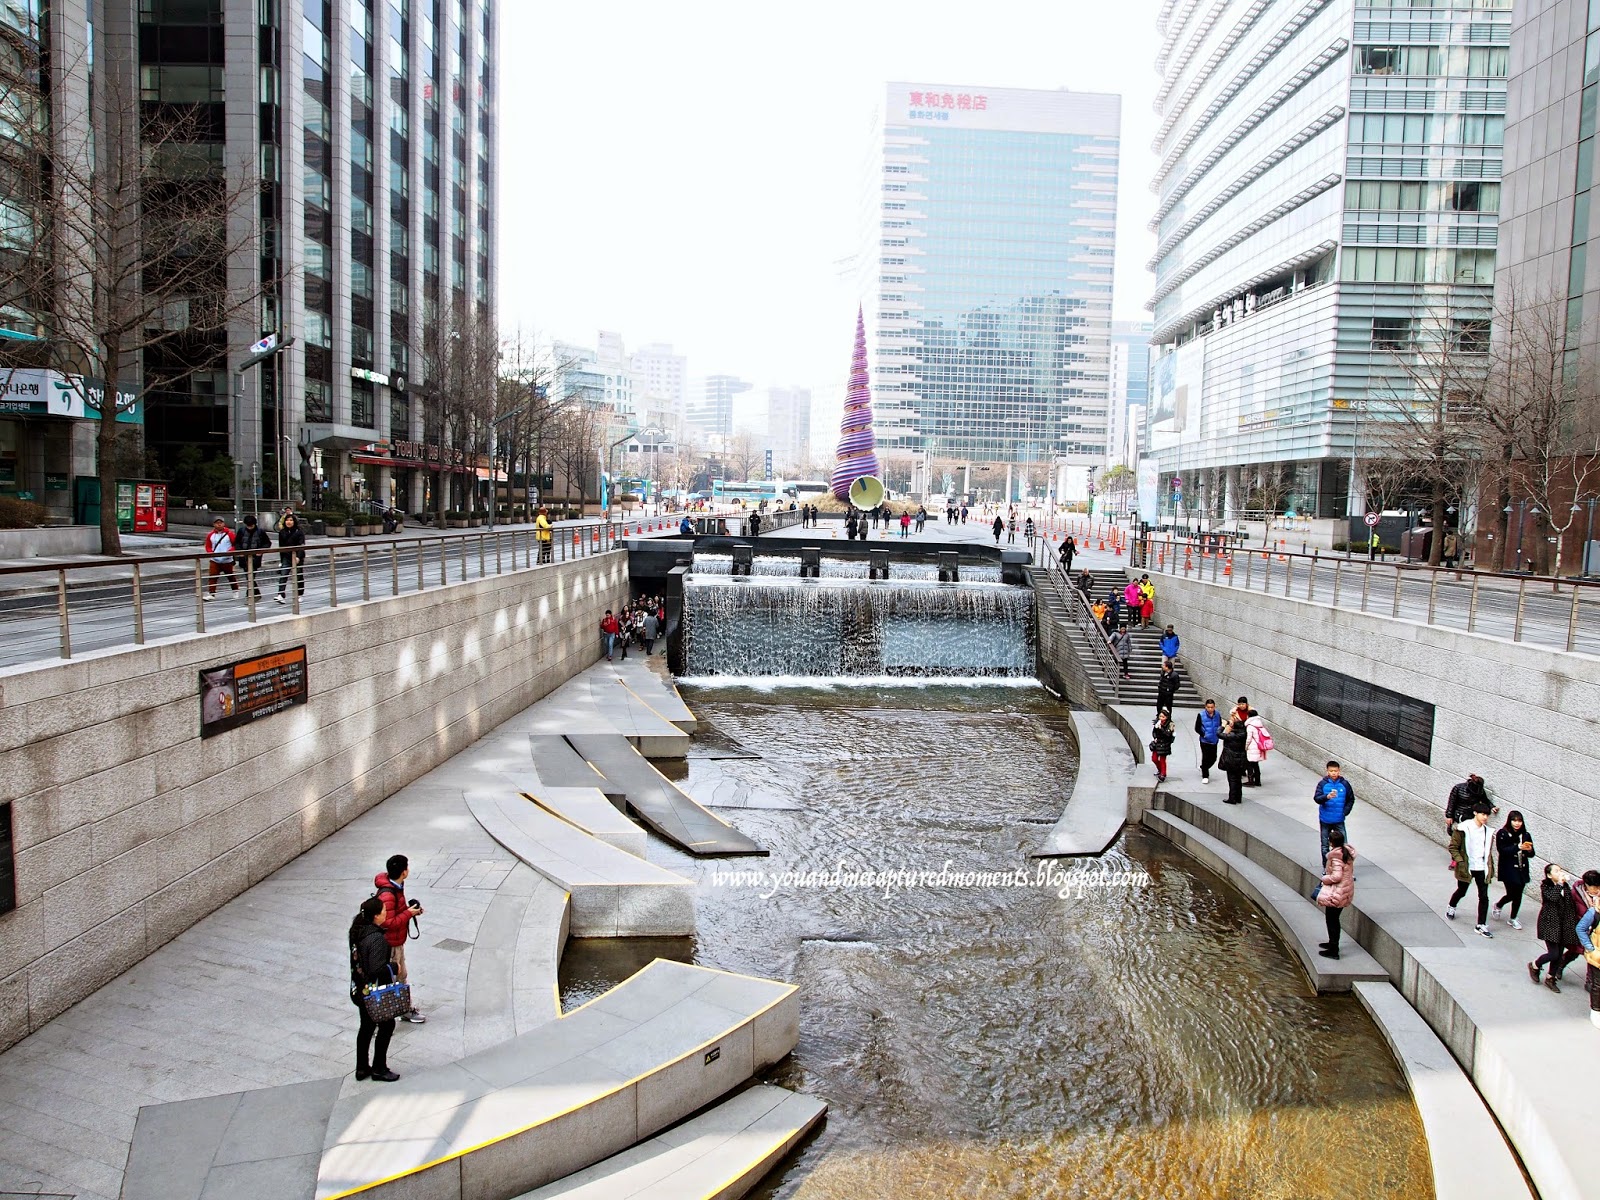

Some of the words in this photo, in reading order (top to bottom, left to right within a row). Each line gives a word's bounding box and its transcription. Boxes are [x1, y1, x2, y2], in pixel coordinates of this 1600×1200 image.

[1213, 292, 1256, 330] 동아일보
[87, 386, 136, 415] 하은행
[419, 443, 439, 460] TMS
